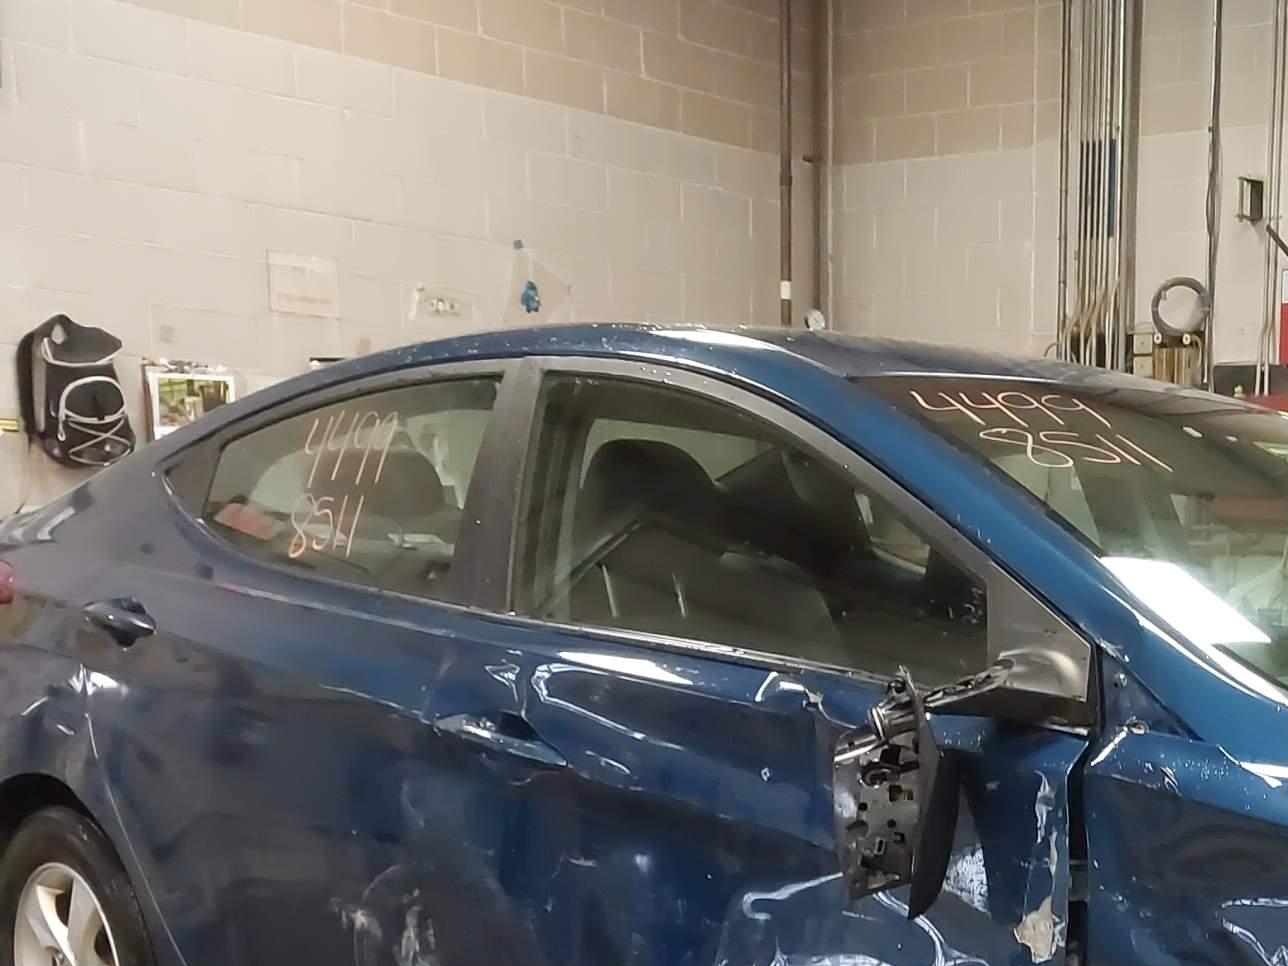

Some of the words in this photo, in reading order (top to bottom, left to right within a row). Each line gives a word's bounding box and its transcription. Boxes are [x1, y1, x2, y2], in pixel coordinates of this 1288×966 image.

[910, 389, 1112, 429] 4499
[304, 409, 399, 489] 4499
[979, 427, 1174, 473] 8511
[288, 492, 365, 558] 8511
